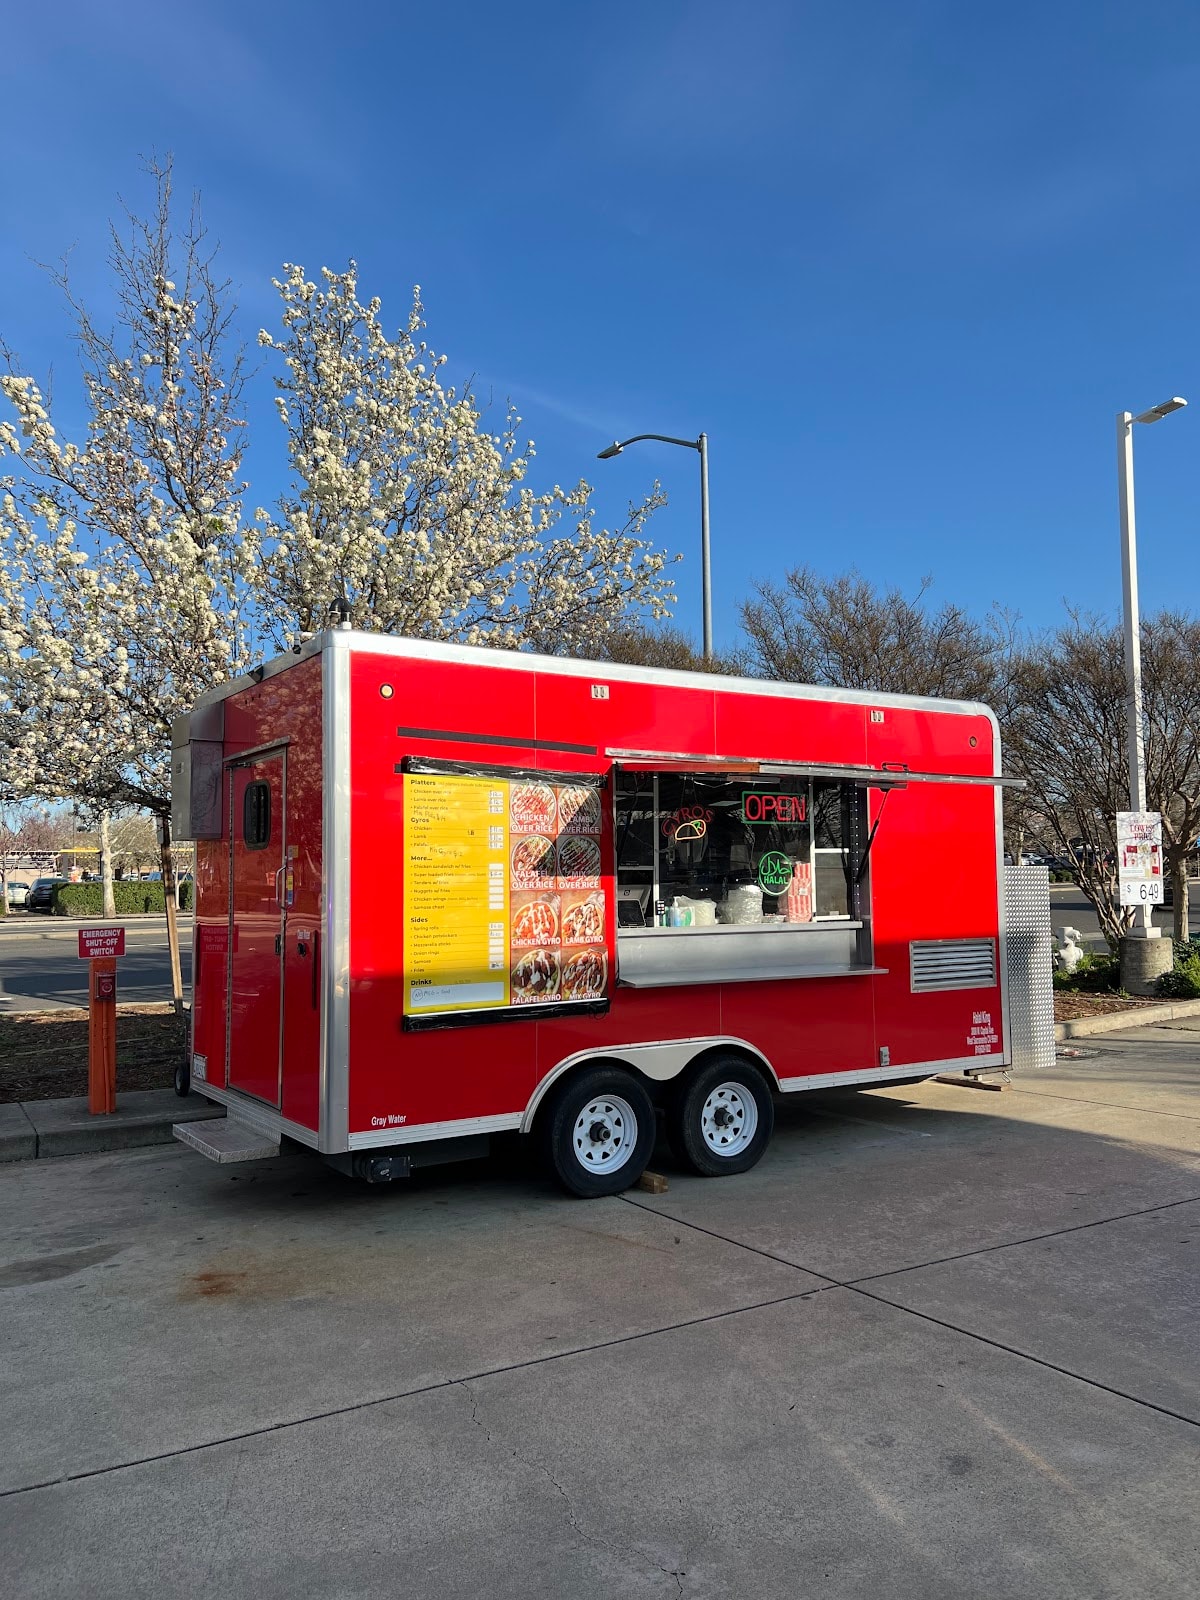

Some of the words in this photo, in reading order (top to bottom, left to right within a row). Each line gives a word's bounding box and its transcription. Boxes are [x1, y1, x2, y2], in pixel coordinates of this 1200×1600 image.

[745, 794, 806, 822] OPEN
[662, 806, 714, 837] GYROS
[512, 824, 535, 832] OVER
[536, 824, 553, 832] RICE
[763, 875, 788, 885] HALAL
[1126, 884, 1132, 893] $
[1140, 884, 1158, 900] 6.49
[82, 928, 121, 938] EMERGENCY
[85, 938, 118, 947] SHUT-OFF
[511, 938, 541, 946] CHICKEN
[542, 936, 561, 945] GYRO
[585, 935, 604, 943] GYRO
[90, 947, 114, 956] SWITCH
[512, 996, 540, 1004] FALAFEL
[542, 994, 561, 1002] GYRO
[371, 1116, 387, 1127] Gray
[388, 1114, 407, 1124] Water
